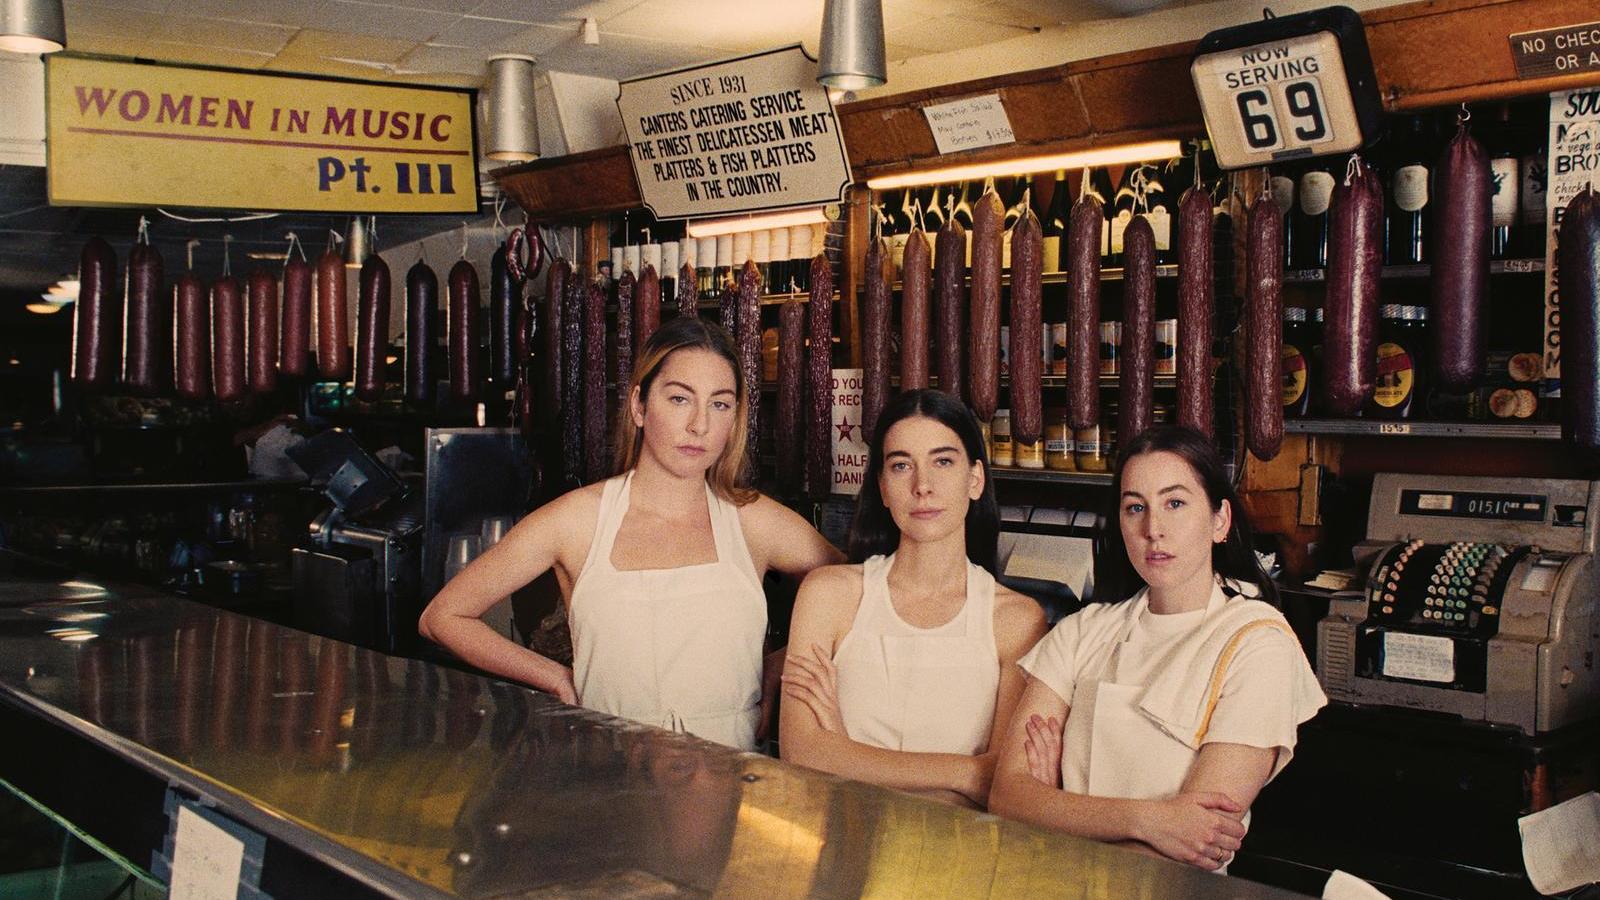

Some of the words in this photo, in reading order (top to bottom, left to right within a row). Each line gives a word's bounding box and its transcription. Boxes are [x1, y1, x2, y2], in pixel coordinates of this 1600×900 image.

[1242, 47, 1290, 66] NOW
[1522, 38, 1546, 54] NO
[1225, 56, 1319, 88] SERVING
[1555, 54, 1579, 70] OR
[670, 77, 714, 105] SINCE
[719, 76, 747, 94] 1931
[75, 86, 254, 130] WOMEN
[270, 108, 310, 134] IN
[322, 106, 452, 142] MUSIC
[640, 111, 688, 136] CANTERS
[690, 100, 747, 130] CATERING
[750, 90, 805, 118] SERVICE
[1236, 81, 1326, 149] 69
[635, 142, 656, 161] THE
[657, 134, 694, 157] FINEST
[696, 121, 786, 154] DELICATESSEN
[653, 158, 704, 182] PLATTERS
[709, 156, 717, 175] &
[720, 153, 749, 174] FISH
[751, 141, 816, 170] PLATTERS
[1556, 153, 1600, 174] BRO
[686, 182, 699, 201] IN
[701, 180, 725, 199] THE
[727, 172, 788, 197] COUNTRY.
[839, 394, 863, 406] REC
[838, 455, 867, 466] HALF
[835, 472, 865, 484] DANI
